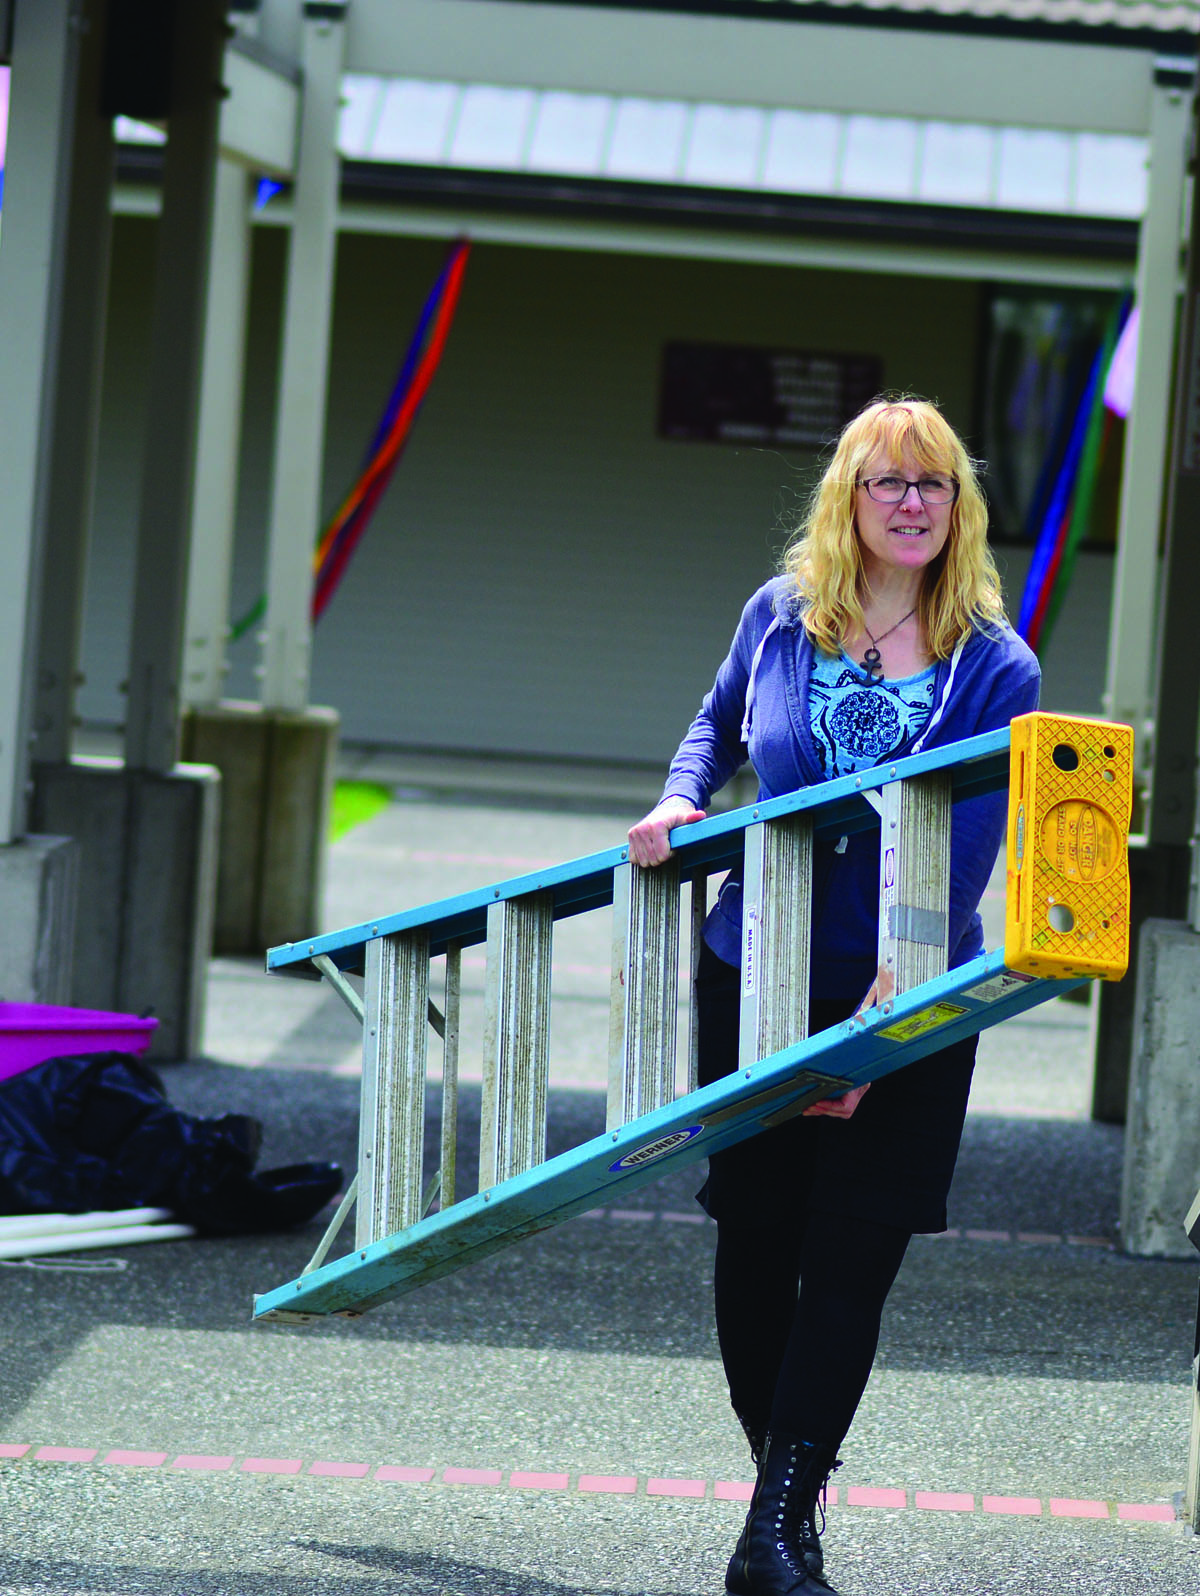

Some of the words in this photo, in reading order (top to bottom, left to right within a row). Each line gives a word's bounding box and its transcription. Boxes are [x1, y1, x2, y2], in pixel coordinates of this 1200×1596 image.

[1082, 821, 1095, 869] DANGER
[748, 954, 752, 962] IN
[624, 1133, 686, 1164] WERNER
